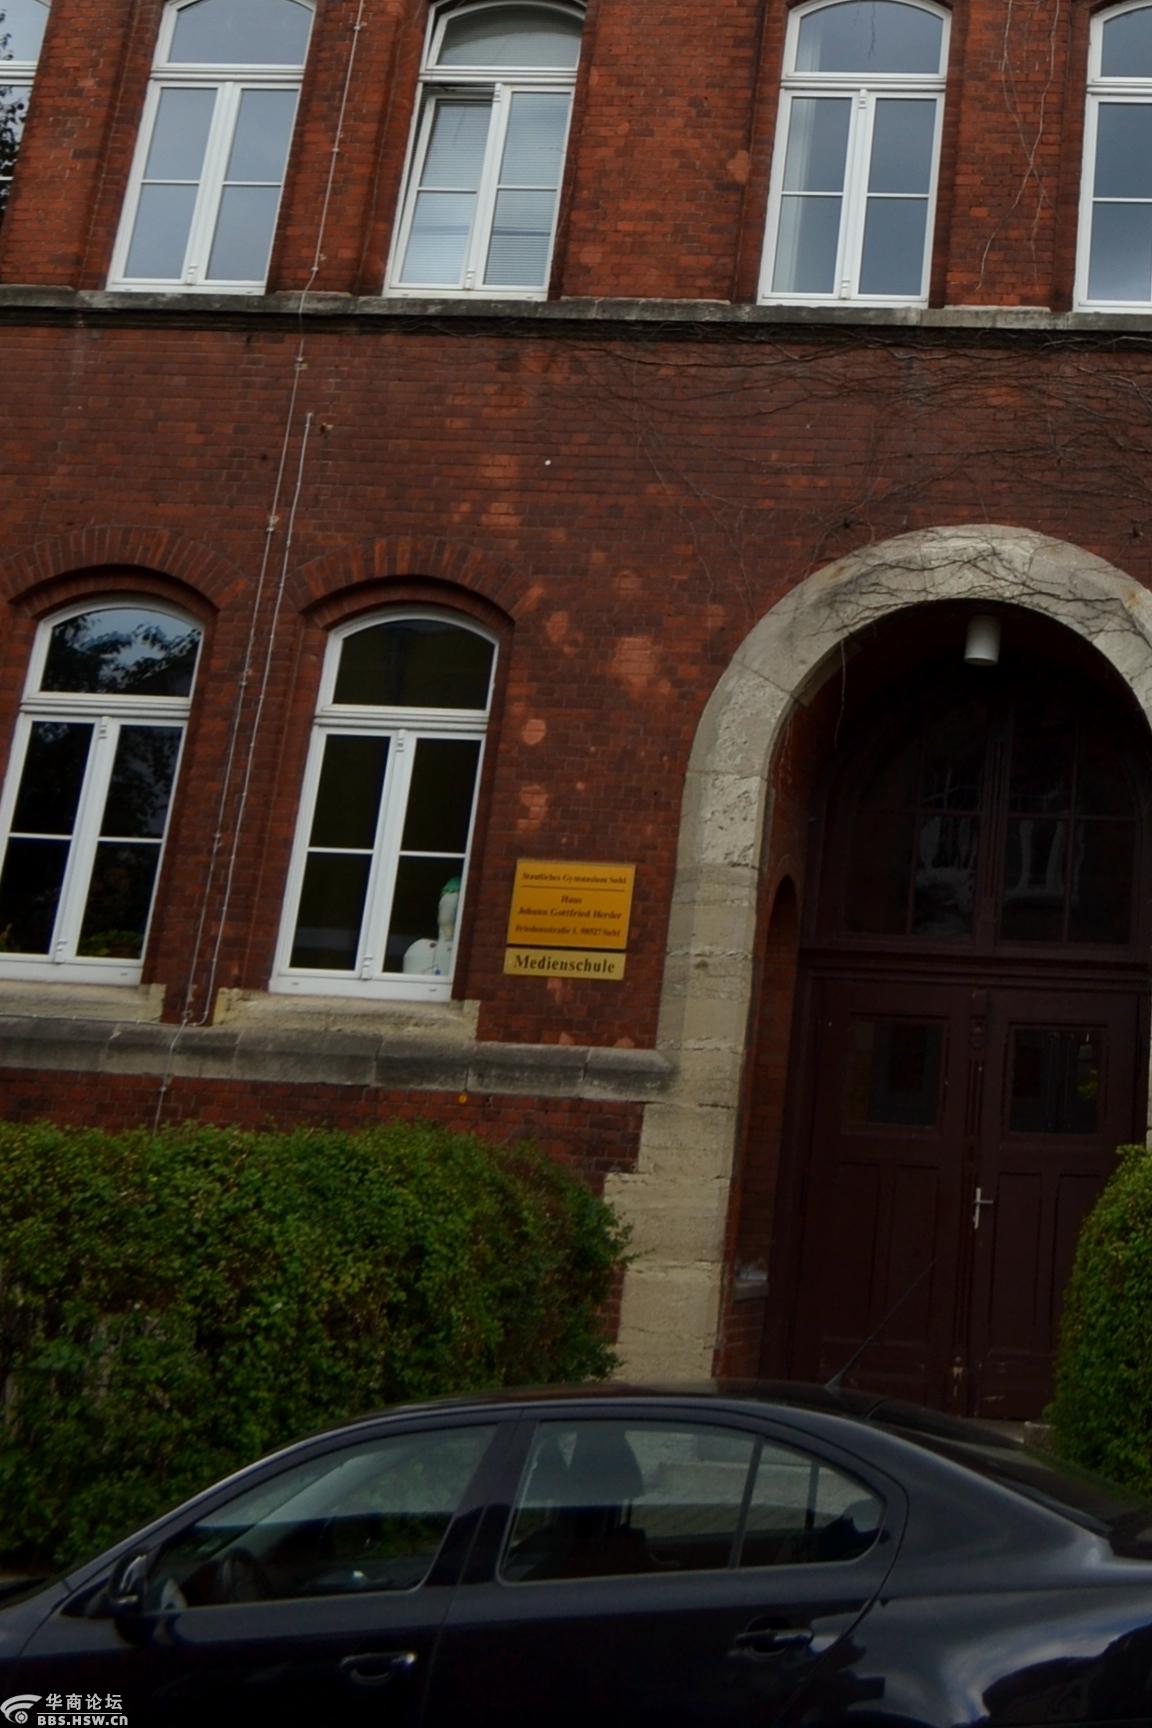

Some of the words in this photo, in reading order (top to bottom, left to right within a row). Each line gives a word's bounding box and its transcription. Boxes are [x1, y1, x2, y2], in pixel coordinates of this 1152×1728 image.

[561, 895, 583, 904] Haus
[518, 906, 548, 916] Johann
[550, 908, 591, 918] Gottfried
[593, 910, 623, 920] Herder
[513, 954, 615, 974] Medienschule
